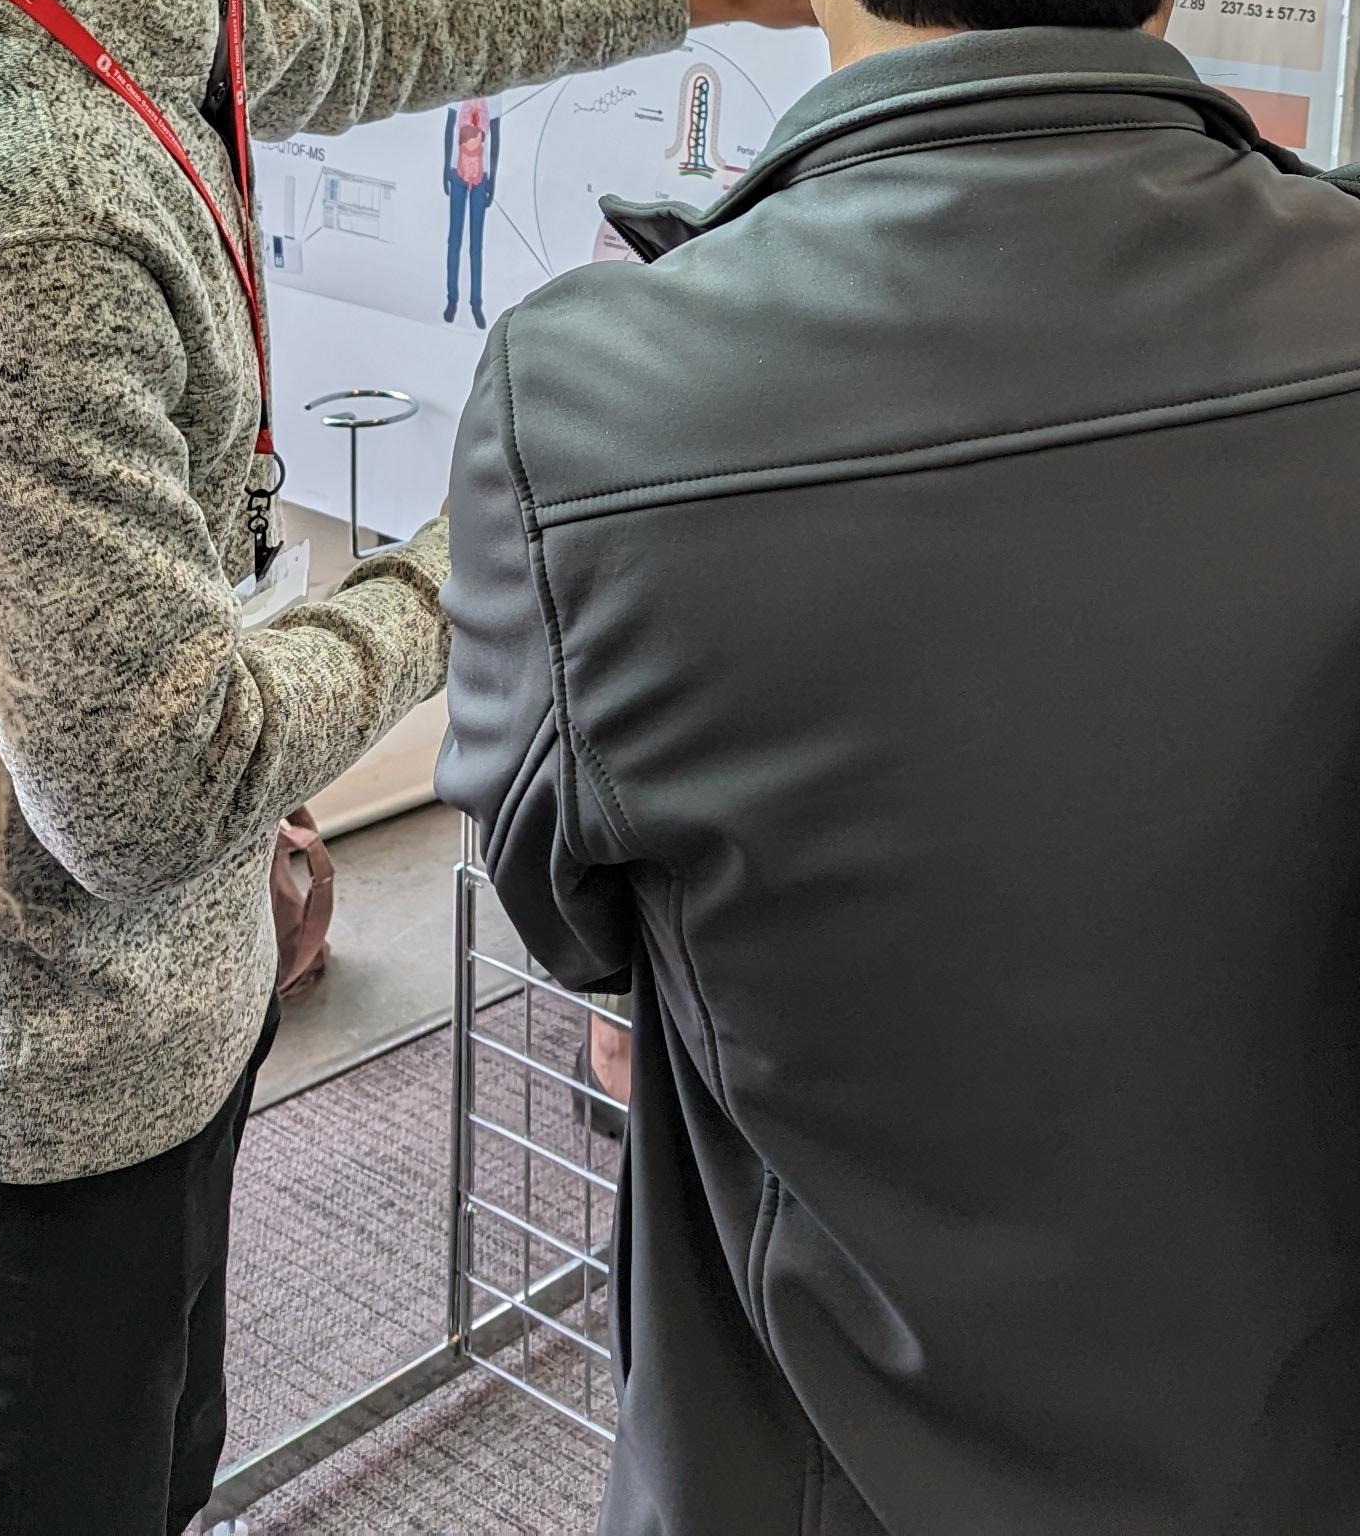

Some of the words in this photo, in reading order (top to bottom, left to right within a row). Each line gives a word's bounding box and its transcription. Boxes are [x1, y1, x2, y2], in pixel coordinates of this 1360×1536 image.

[1221, 1, 1262, 18] 237.53
[1277, 7, 1316, 23] 57.73
[141, 100, 160, 124] STATE
